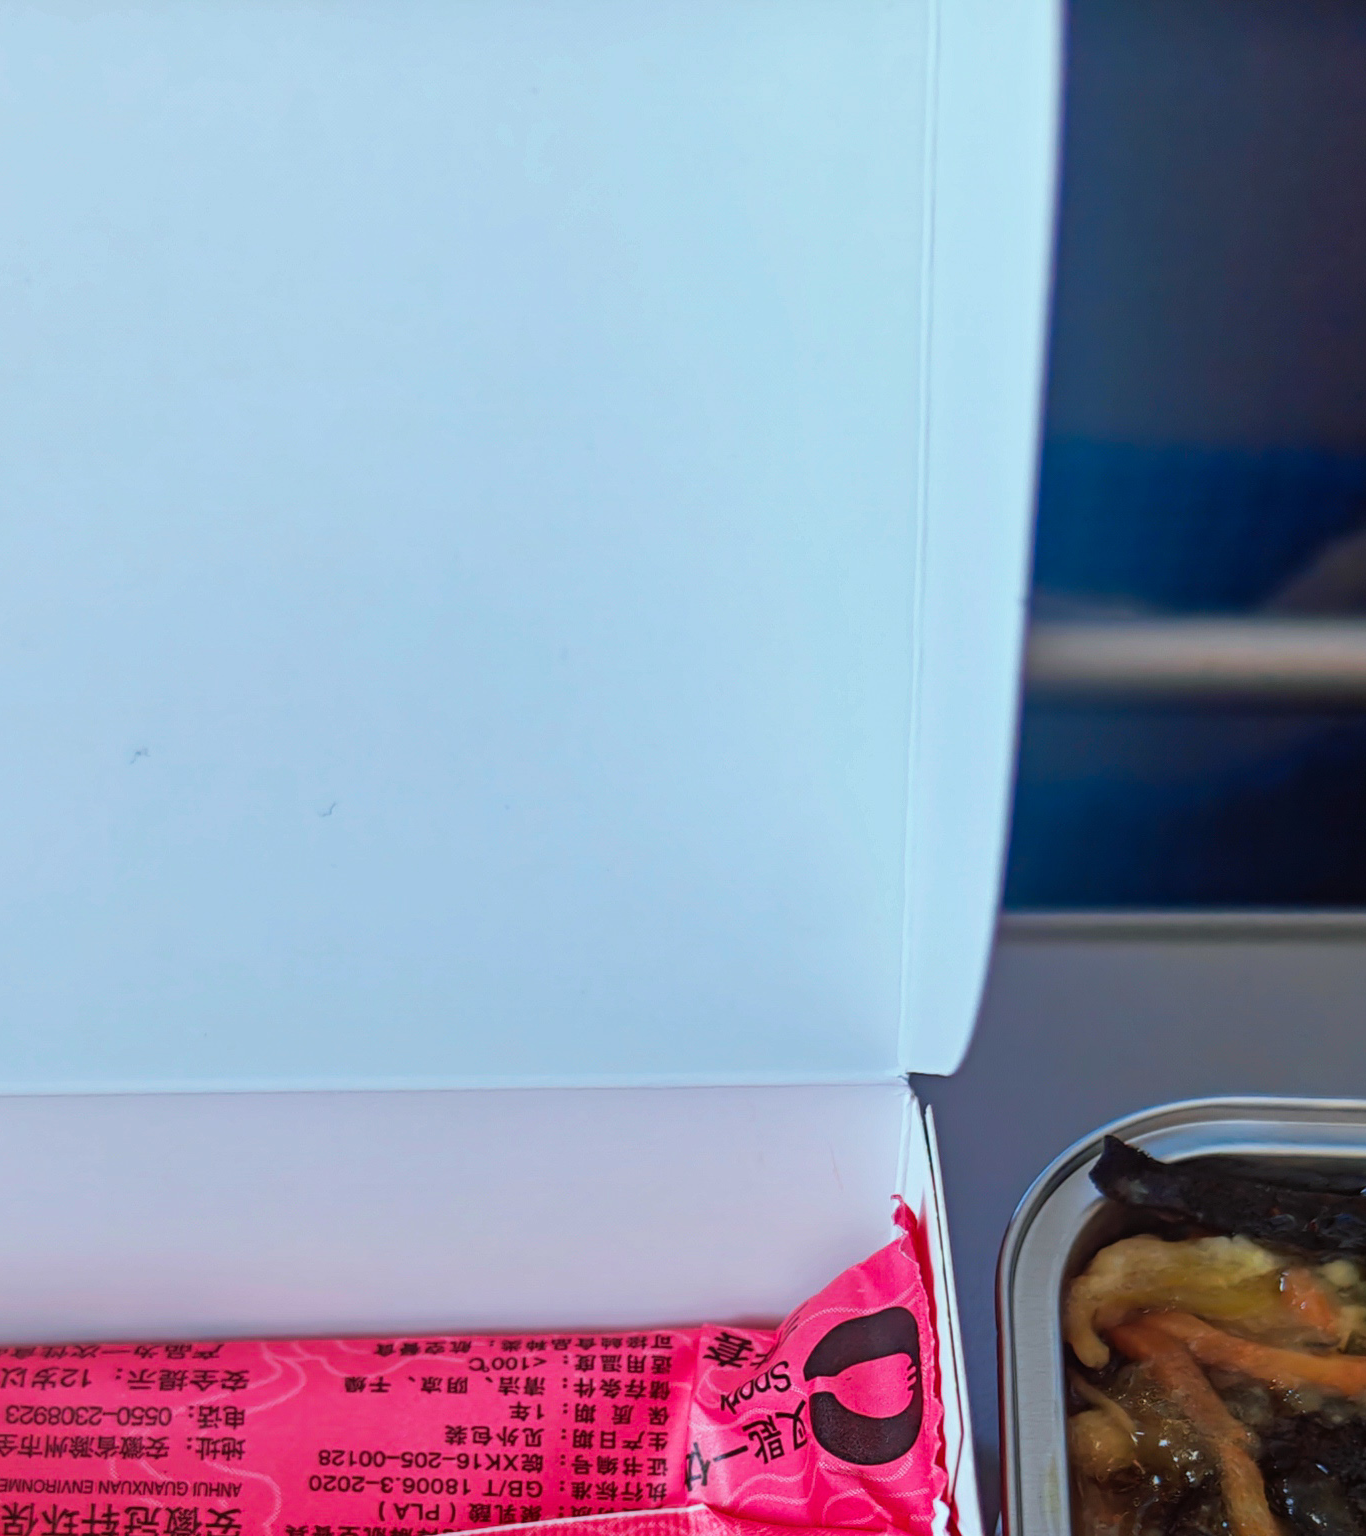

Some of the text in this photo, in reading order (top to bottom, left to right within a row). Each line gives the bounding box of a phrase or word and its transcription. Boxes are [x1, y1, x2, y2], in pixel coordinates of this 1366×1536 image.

[720, 1361, 792, 1414] Spork
[98, 1480, 189, 1498] GUANXUAN
[192, 1482, 242, 1498] ANHUI
